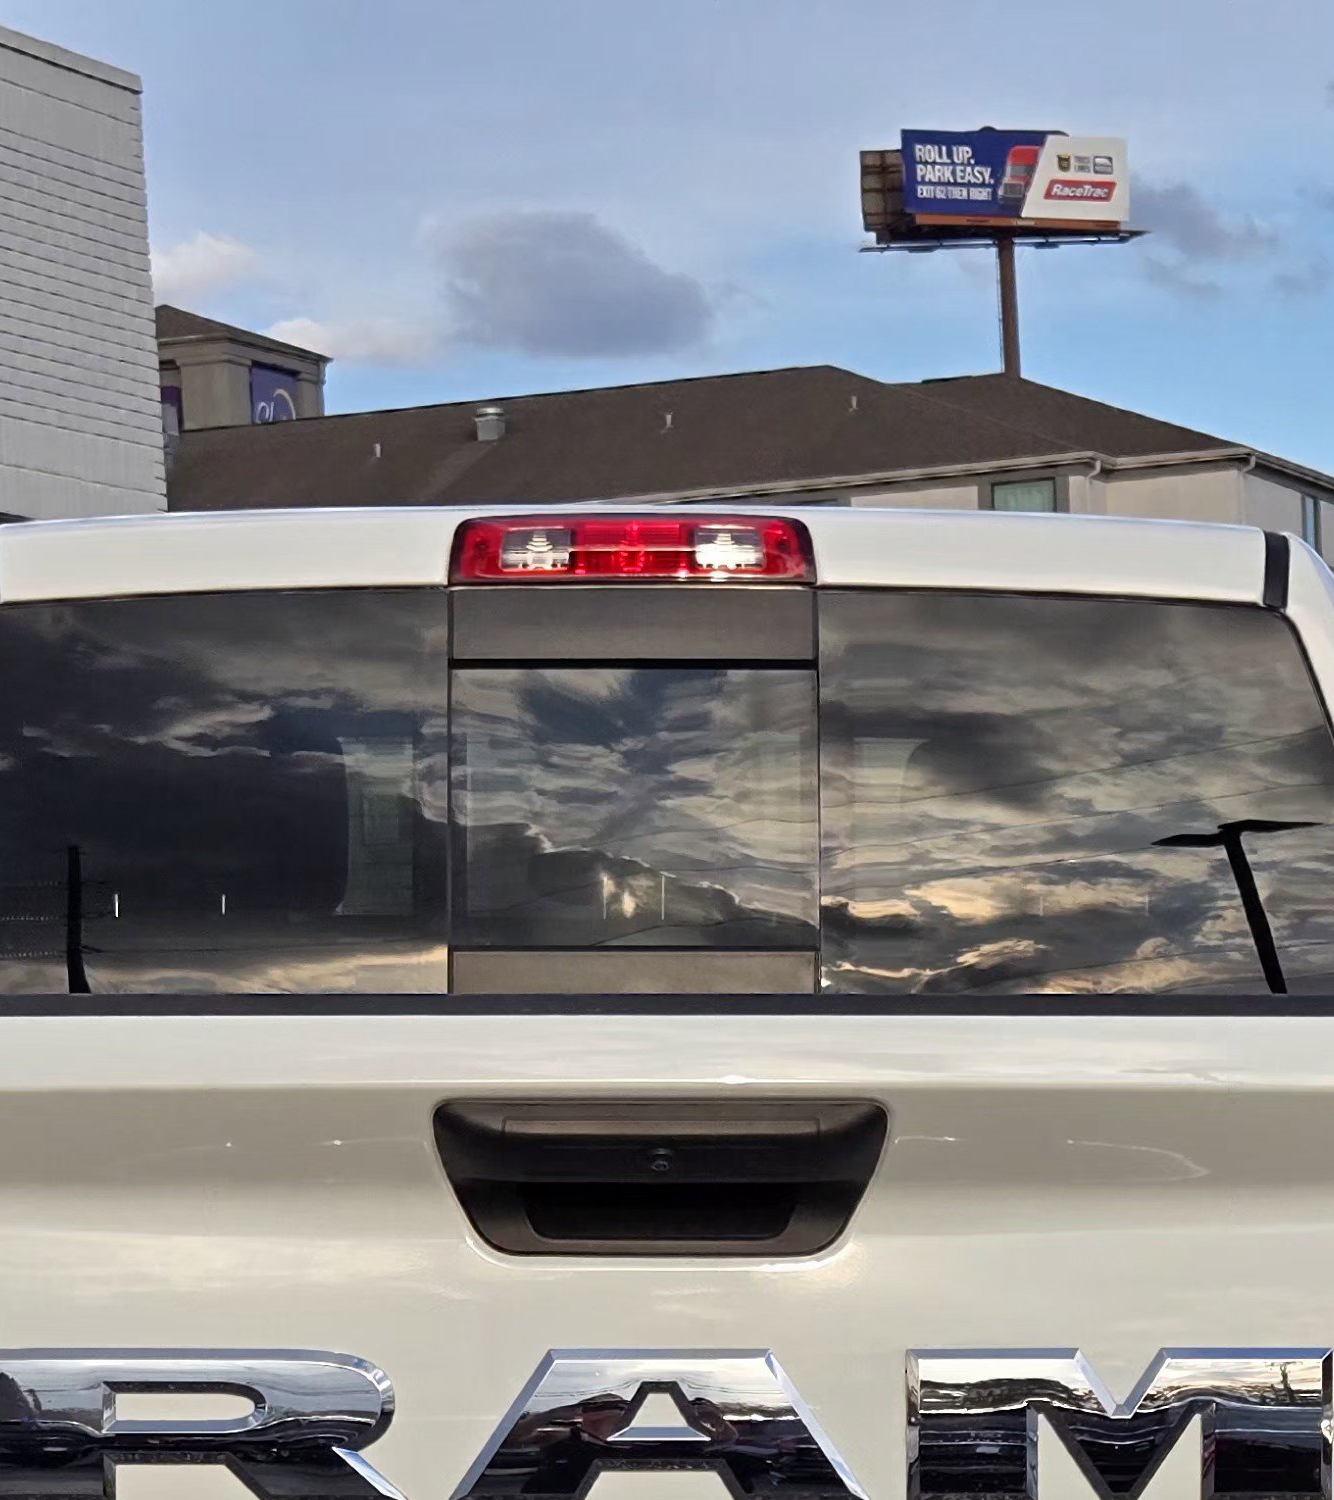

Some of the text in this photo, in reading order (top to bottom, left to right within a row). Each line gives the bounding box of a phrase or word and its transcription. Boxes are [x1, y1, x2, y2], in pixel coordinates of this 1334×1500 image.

[915, 145, 975, 165] ROLL UP.
[916, 165, 994, 184] PARK EASY.
[917, 186, 934, 199] EXIT
[1051, 183, 1109, 197] RaceTrac
